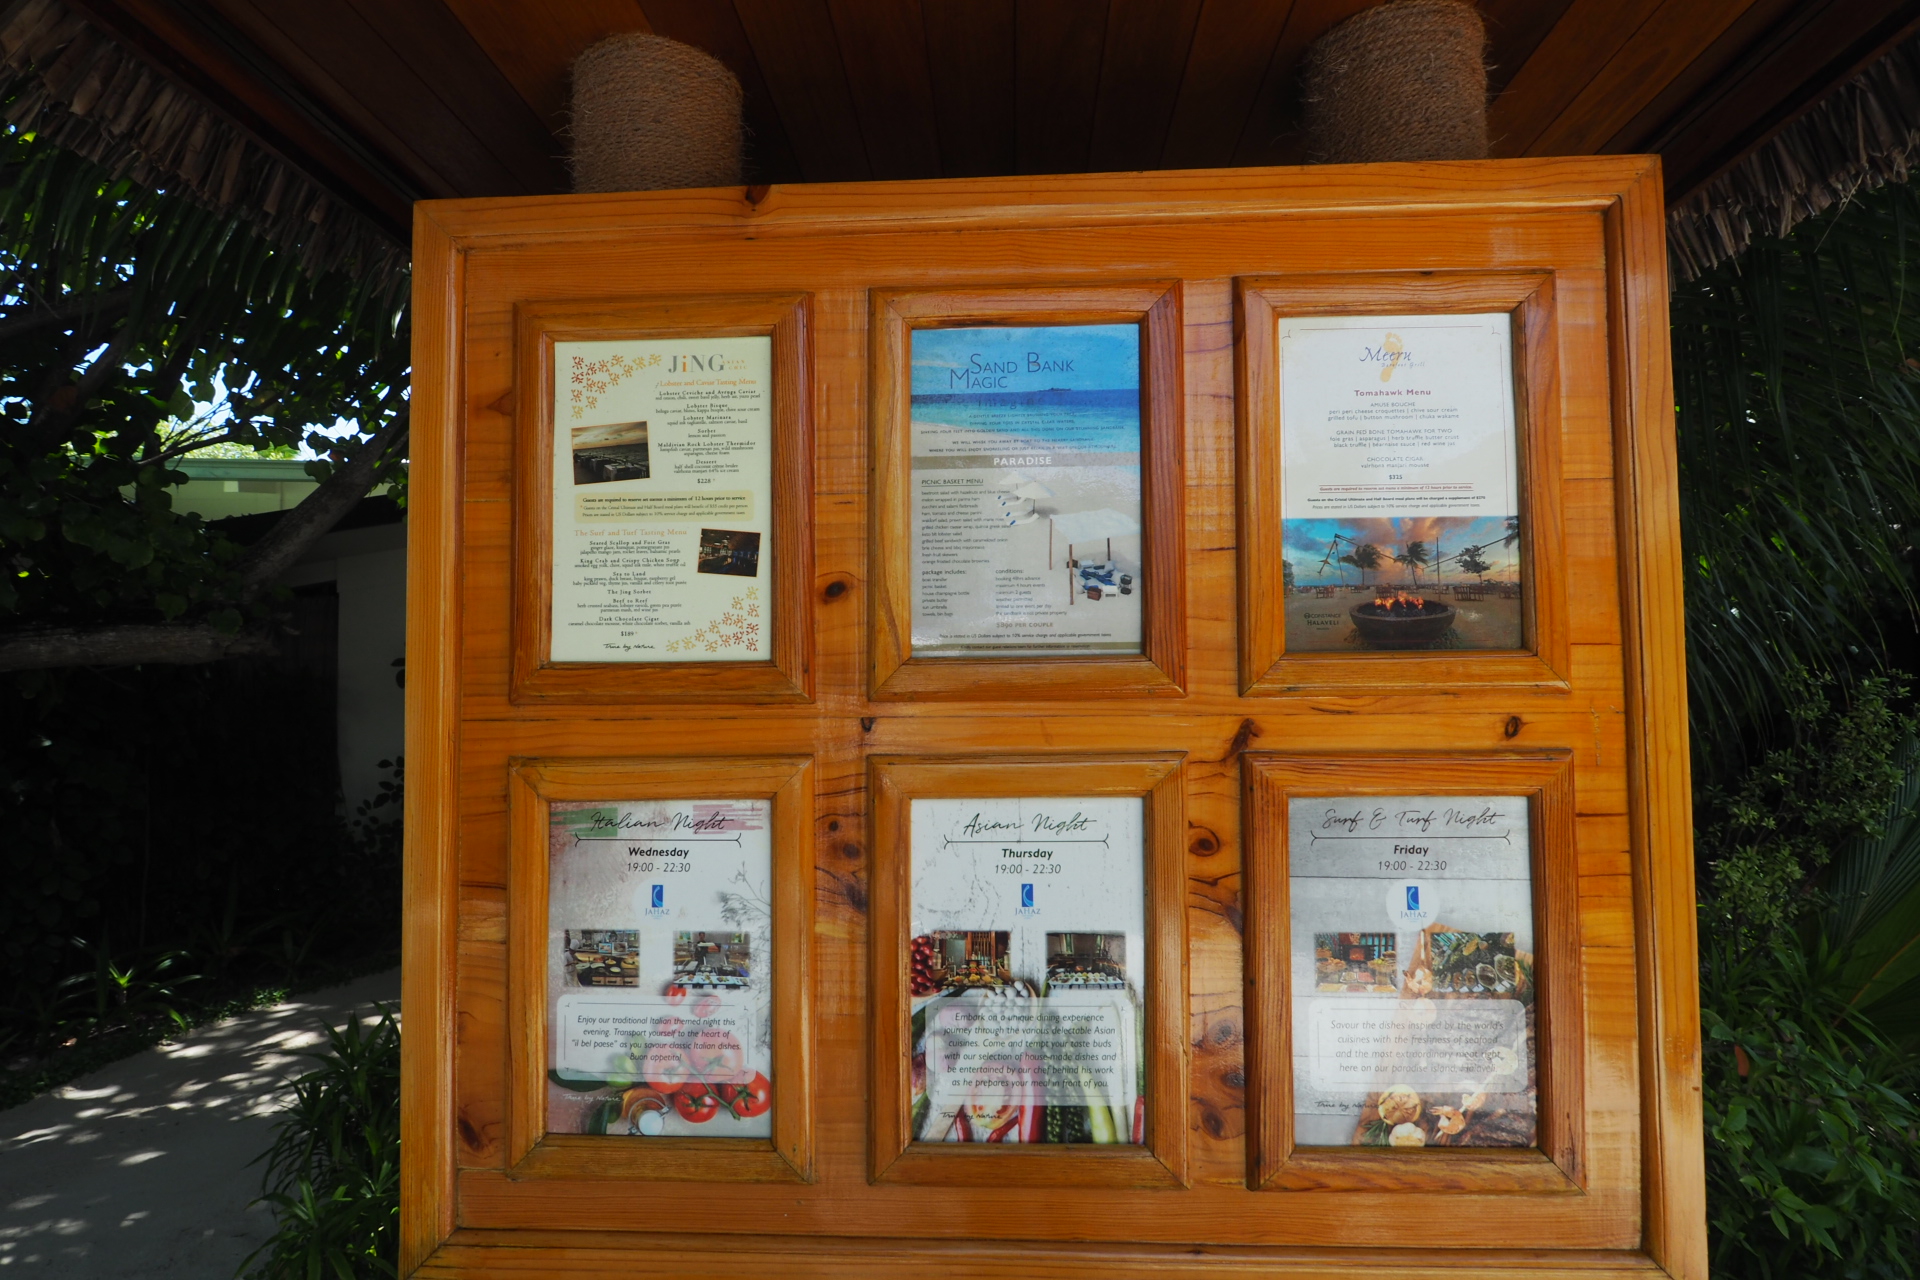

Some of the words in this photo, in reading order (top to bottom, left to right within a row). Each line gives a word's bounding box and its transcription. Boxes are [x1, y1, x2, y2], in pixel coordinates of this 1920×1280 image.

[1359, 346, 1412, 362] Meeru
[950, 369, 1008, 389] MAGIC
[1354, 389, 1402, 397] Tomahawk
[994, 457, 1052, 465] PARADISE
[574, 528, 588, 536] The
[589, 528, 605, 536] Surf
[607, 528, 621, 536] and
[639, 528, 665, 537] Tasting
[667, 527, 687, 535] Menu
[921, 568, 943, 577] package
[590, 811, 665, 831] Italian
[671, 812, 734, 834] Night
[963, 813, 1023, 837] Asian
[1031, 812, 1097, 835] Night
[1322, 809, 1364, 832] Surf
[1369, 807, 1387, 828] &
[1395, 810, 1437, 832] Turf
[1443, 807, 1506, 829] Night
[628, 847, 690, 859] Wednesday
[1002, 849, 1053, 860] Thursday
[1393, 845, 1429, 856] Friday
[627, 862, 653, 872] 19:00
[663, 862, 690, 872] 22:30
[995, 864, 1022, 874] 19:00
[1033, 864, 1061, 874] 22:30
[1378, 860, 1406, 870] 19:00
[1417, 860, 1447, 870] 22:30
[577, 1015, 596, 1026] Enjoy
[612, 1015, 648, 1025] traditional
[649, 1016, 671, 1025] Italian
[673, 1016, 701, 1025] themed
[702, 1016, 720, 1028] night
[722, 1016, 735, 1025] this
[954, 1012, 985, 1021] Embark
[1007, 1012, 1034, 1023] unique
[1036, 1012, 1059, 1023] dining
[1062, 1012, 1104, 1023] experience
[943, 1028, 971, 1036] journey
[974, 1025, 1004, 1037] through
[1007, 1025, 1019, 1034] the
[1051, 1025, 1091, 1034] delectable
[1094, 1025, 1115, 1034] Asian
[1330, 1020, 1358, 1029] Savour
[1362, 1020, 1376, 1029] the
[1378, 1020, 1405, 1029] dishes
[1408, 1020, 1441, 1032] inspired
[1444, 1020, 1455, 1032] by
[1457, 1020, 1471, 1029] the
[614, 1027, 646, 1039] Transport
[648, 1028, 677, 1039] yourself
[678, 1028, 685, 1037] to
[687, 1028, 699, 1037] the
[700, 1028, 720, 1037] heart
[722, 1028, 731, 1040] of
[1337, 1034, 1370, 1043] cuisines
[1372, 1034, 1391, 1043] with
[1394, 1034, 1408, 1043] the
[1411, 1034, 1451, 1045] freshness
[1453, 1034, 1463, 1045] of
[1464, 1034, 1498, 1043] seafood
[580, 1038, 592, 1048] bel
[629, 1042, 642, 1051] you
[669, 1039, 691, 1049] classic
[693, 1040, 715, 1049] Italian
[982, 1038, 1005, 1047] Come
[1007, 1038, 1023, 1047] and
[1025, 1038, 1049, 1050] tempt
[1050, 1041, 1068, 1050] your
[1070, 1038, 1090, 1047] taste
[1092, 1038, 1112, 1047] buds
[944, 1051, 960, 1060] with
[978, 1051, 1013, 1060] selection
[1014, 1051, 1024, 1063] of
[1075, 1052, 1098, 1061] dishes
[1101, 1052, 1117, 1061] and
[946, 1064, 956, 1073] be
[959, 1064, 1004, 1073] entertained
[1006, 1064, 1016, 1075] by
[1033, 1064, 1050, 1076] chef
[1052, 1064, 1078, 1073] behind
[1081, 1064, 1092, 1073] his
[1094, 1065, 1114, 1074] work
[962, 1077, 972, 1086] he
[974, 1080, 1009, 1089] prepares
[1011, 1080, 1028, 1089] your
[1031, 1077, 1050, 1086] meal
[1052, 1077, 1059, 1086] in
[1062, 1078, 1080, 1089] front
[1083, 1078, 1092, 1089] of
